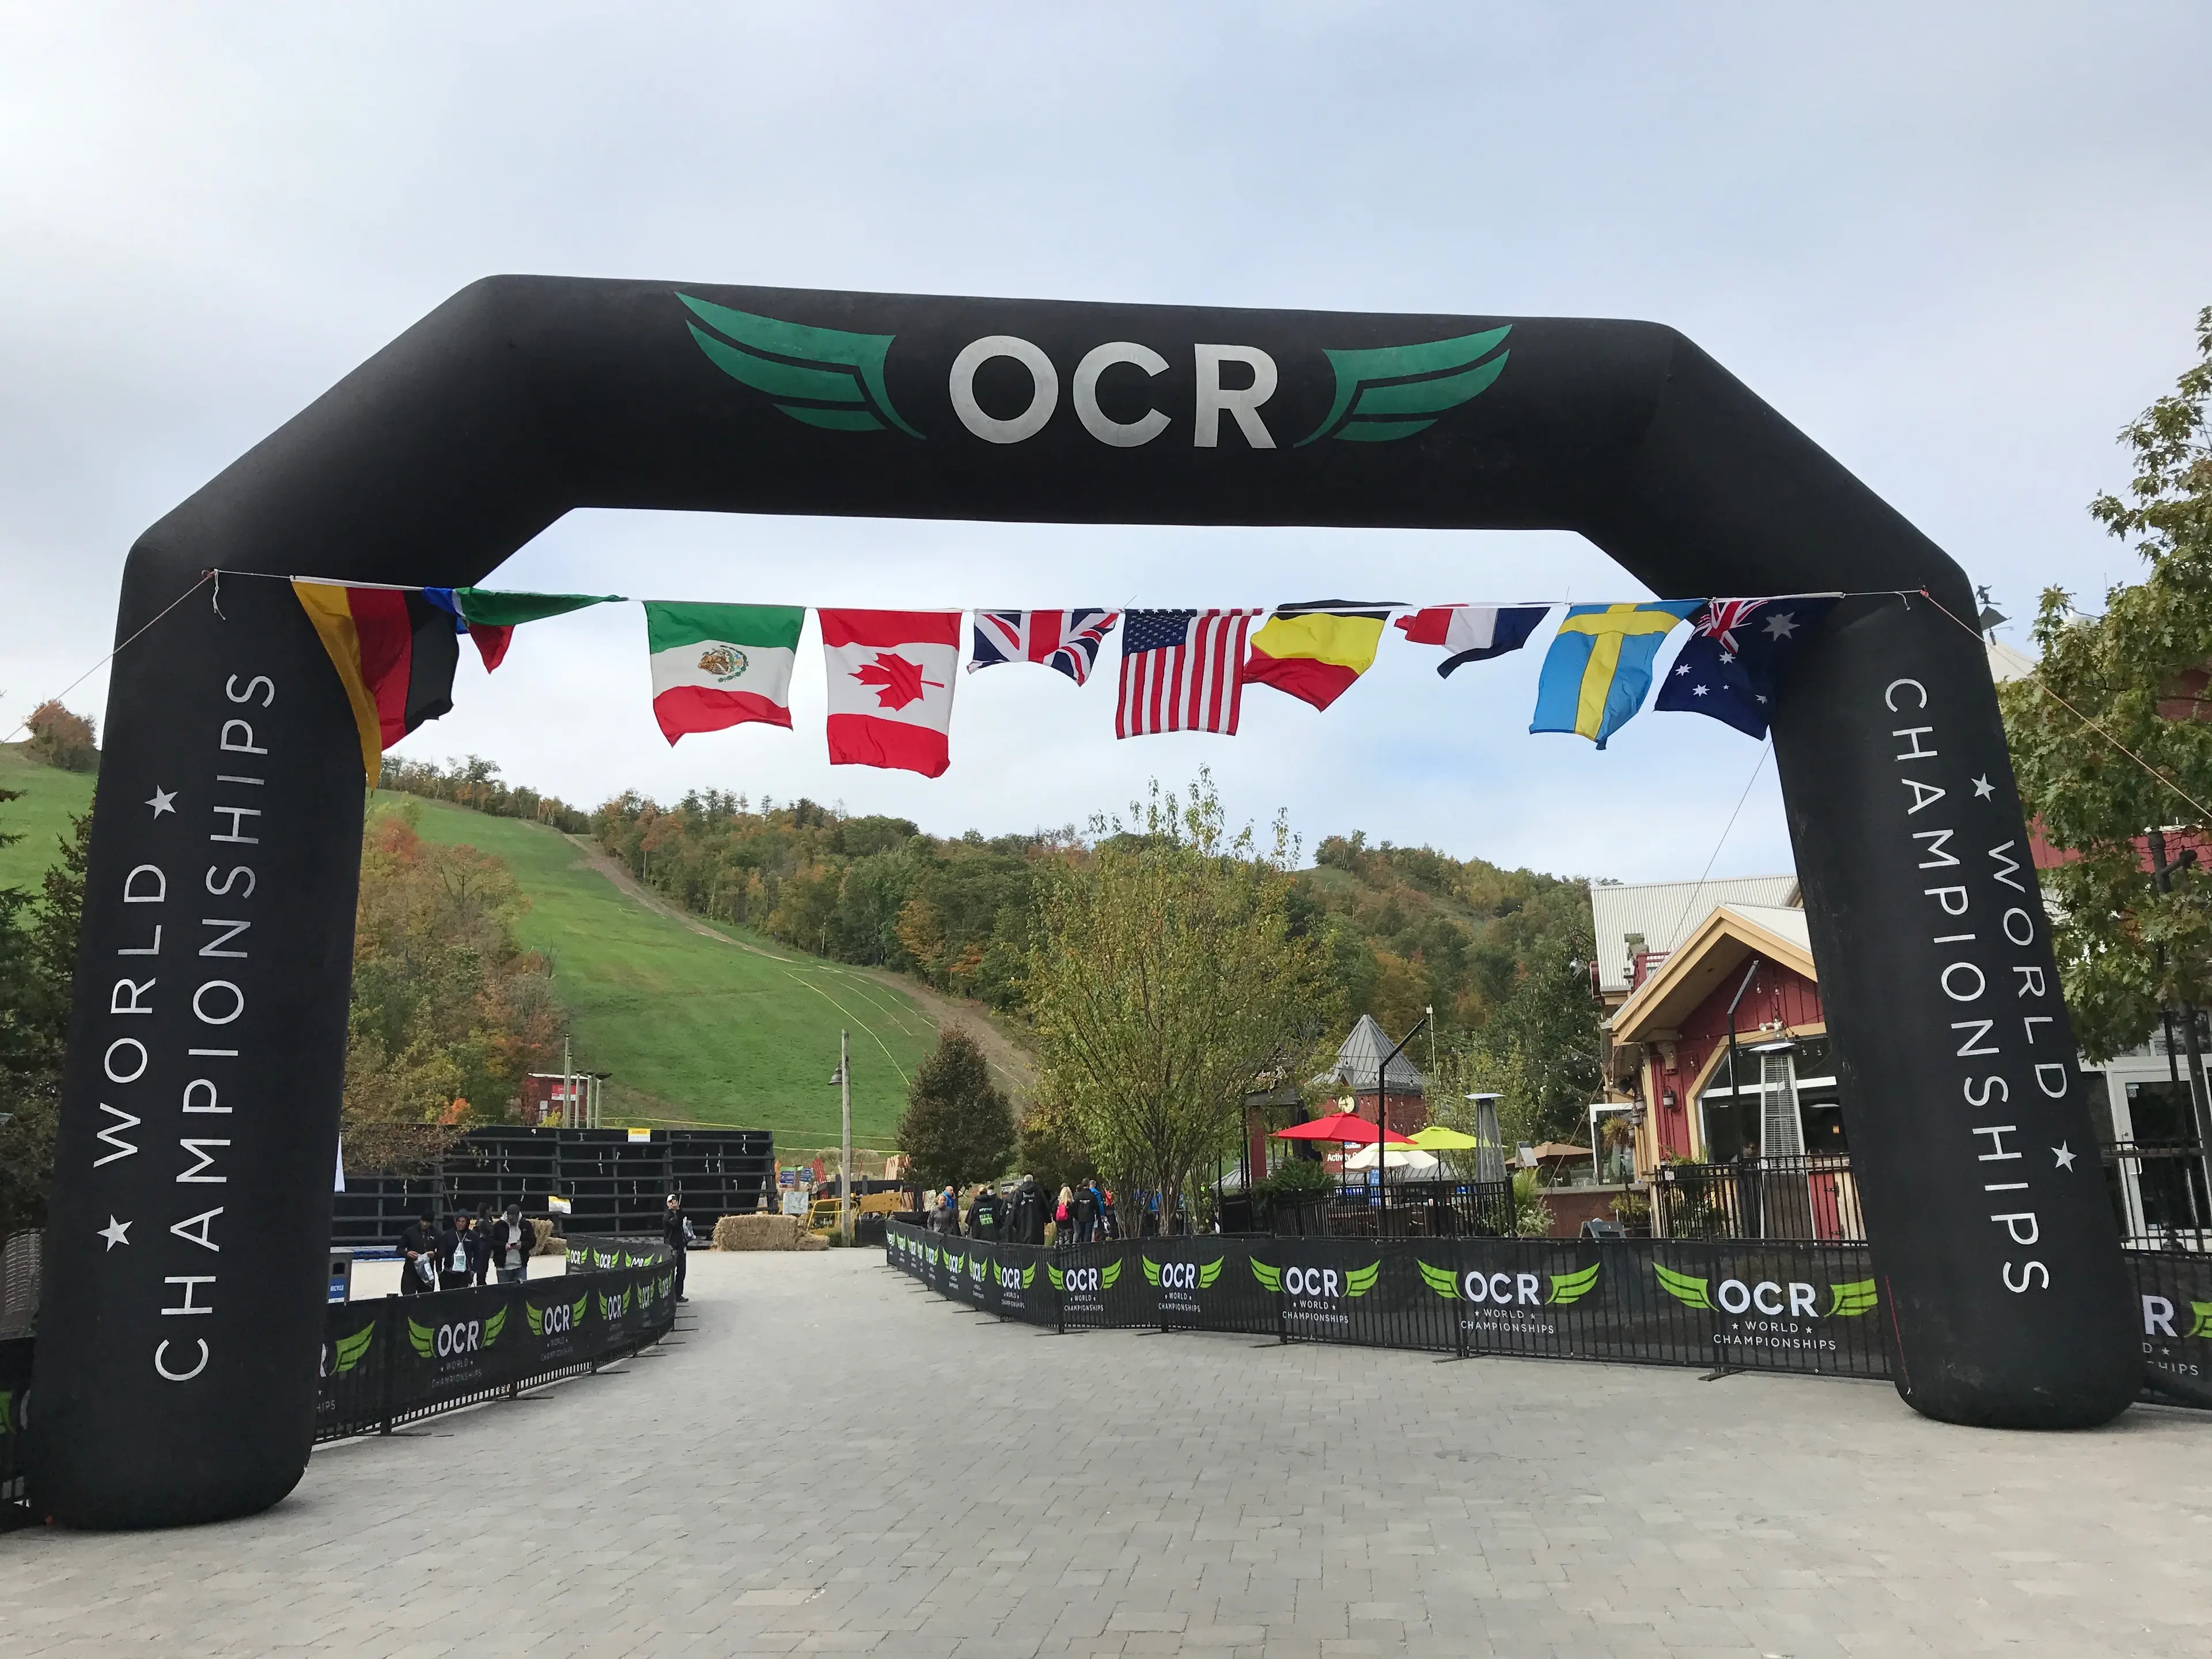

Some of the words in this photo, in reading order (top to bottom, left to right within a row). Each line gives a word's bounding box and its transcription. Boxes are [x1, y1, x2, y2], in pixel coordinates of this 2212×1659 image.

[949, 335, 1277, 448] OCR
[1988, 840, 2066, 1099] WORLD
[1885, 679, 2049, 1293] CHAMPIONSHIPS
[93, 864, 167, 1168] WORLD
[154, 674, 274, 1381] CHAMPIONSHIPS
[1327, 1153, 1351, 1161] Activty
[570, 1250, 581, 1264] OCR
[600, 1253, 611, 1268] OCR
[1002, 1267, 1020, 1289] OCR
[1066, 1268, 1098, 1291] OCR
[1162, 1263, 1195, 1289] OCR
[1286, 1267, 1339, 1297] OCR
[1169, 1292, 1187, 1300] WORLD
[1465, 1271, 1540, 1305] OCR
[1718, 1279, 1819, 1317] OCR
[608, 1294, 622, 1320] OCR
[1158, 1302, 1200, 1312] CHAMPIONSHIPS
[1300, 1300, 1329, 1310] WORLD
[1483, 1309, 1524, 1319] WORLD
[544, 1304, 570, 1335] OCR
[1282, 1311, 1349, 1324] CHAMPIONSHIPS
[1461, 1320, 1554, 1334] CHAMPIONSHIPS
[1745, 1321, 1798, 1332] WORLD
[438, 1320, 479, 1357] OCR
[1713, 1334, 1836, 1350] CHAMPIONSHIPS
[446, 1358, 468, 1370] WORLD
[431, 1369, 482, 1388] CHAMPIONSHIPS
